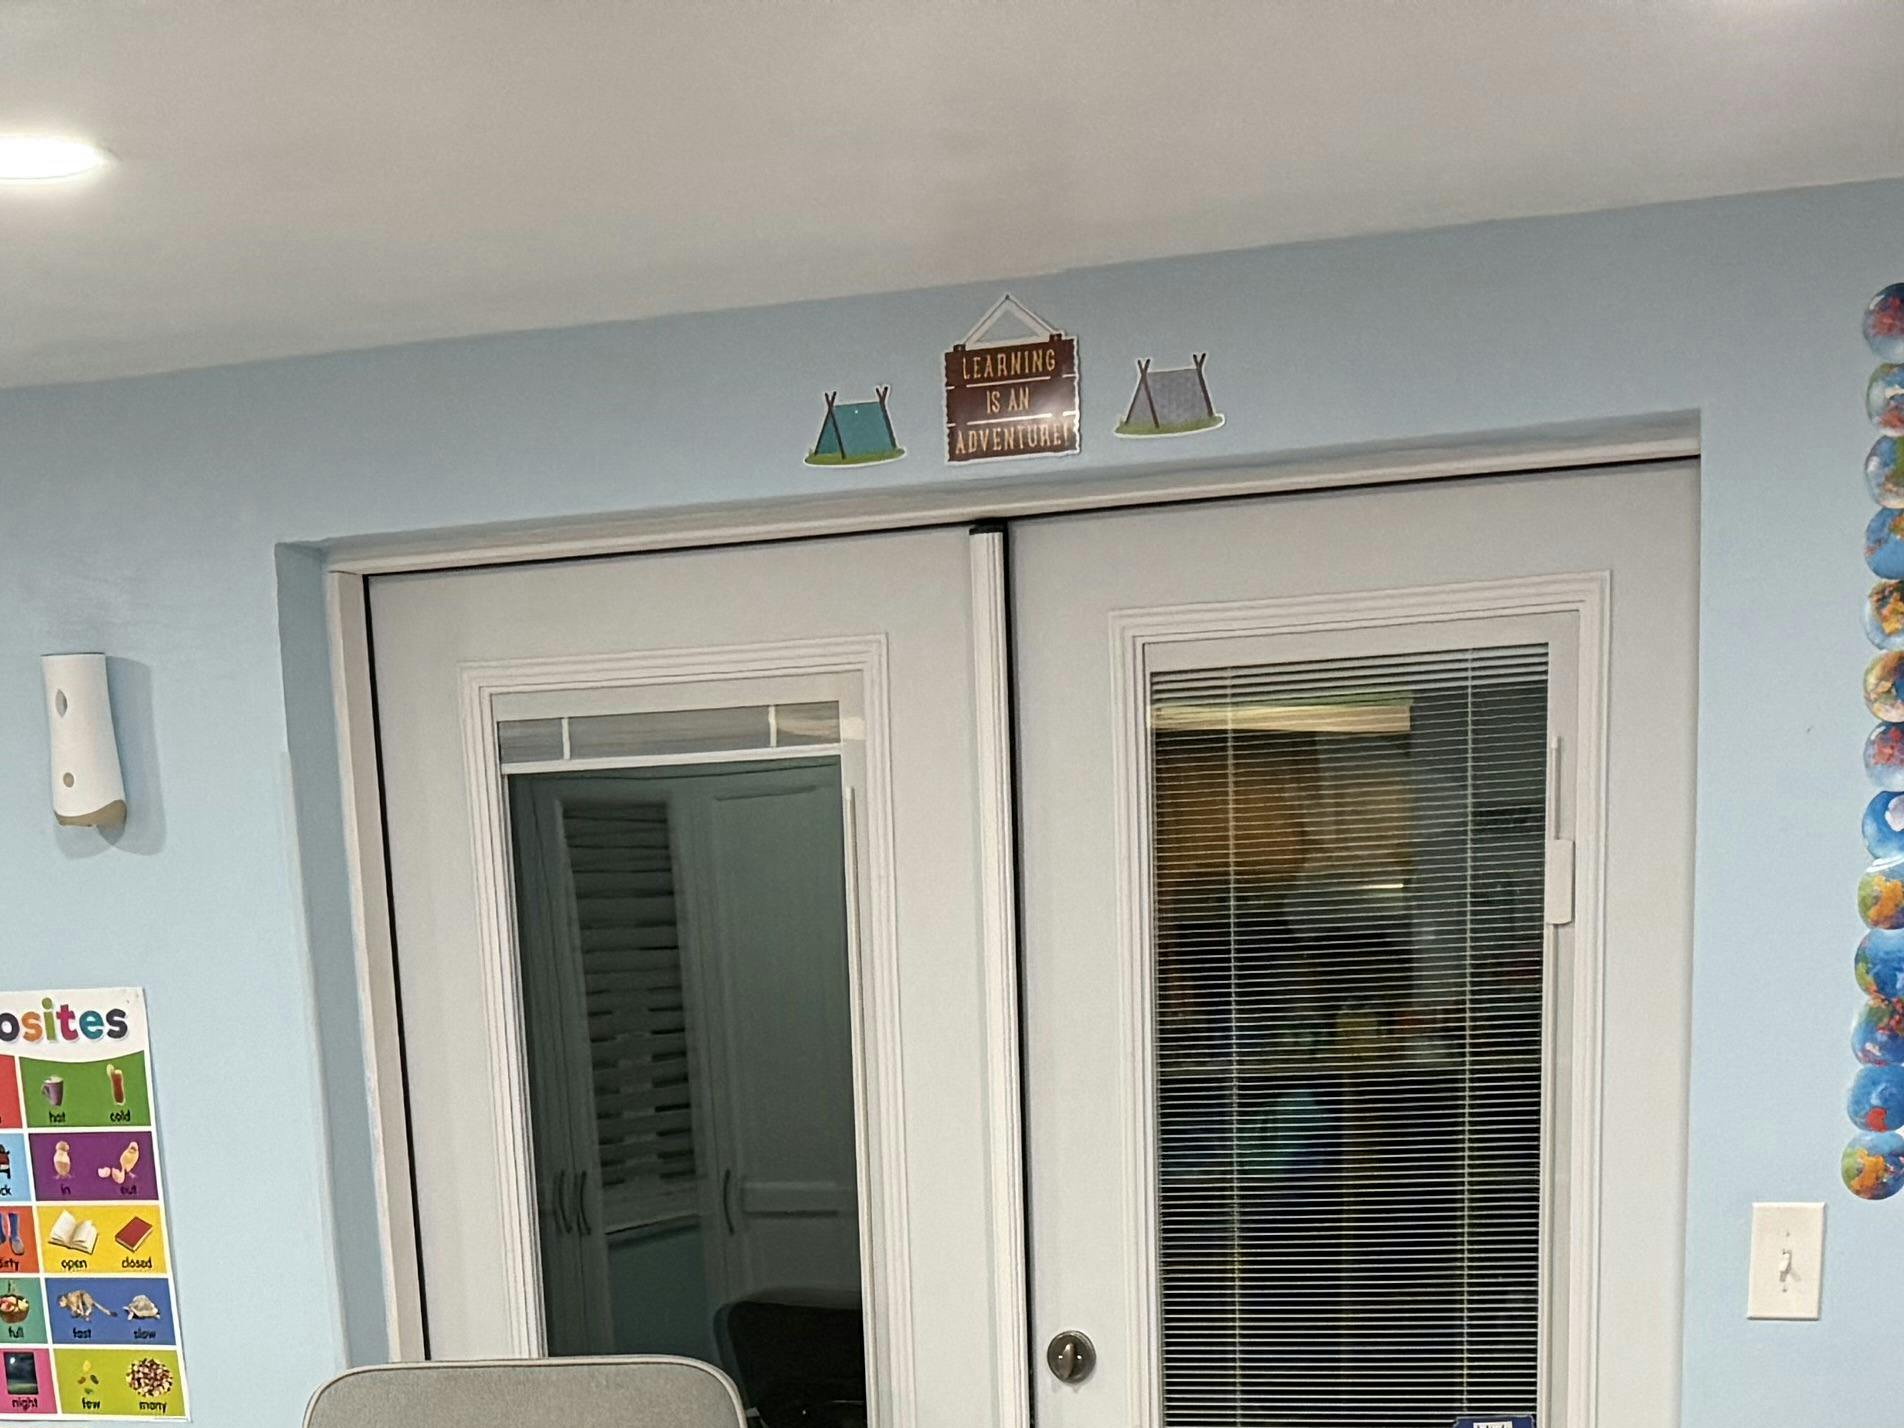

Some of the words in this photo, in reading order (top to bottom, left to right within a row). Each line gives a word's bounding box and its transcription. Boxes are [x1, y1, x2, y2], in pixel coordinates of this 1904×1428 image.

[962, 349, 1056, 380] LEARNING
[986, 392, 1001, 414] IS
[1008, 387, 1030, 411] AN
[955, 420, 1069, 454] ADVENTURE!
[110, 1110, 131, 1122] cold
[61, 1260, 88, 1271] open
[121, 1257, 152, 1269] closed
[12, 1396, 38, 1410] night
[139, 1400, 167, 1412] many
